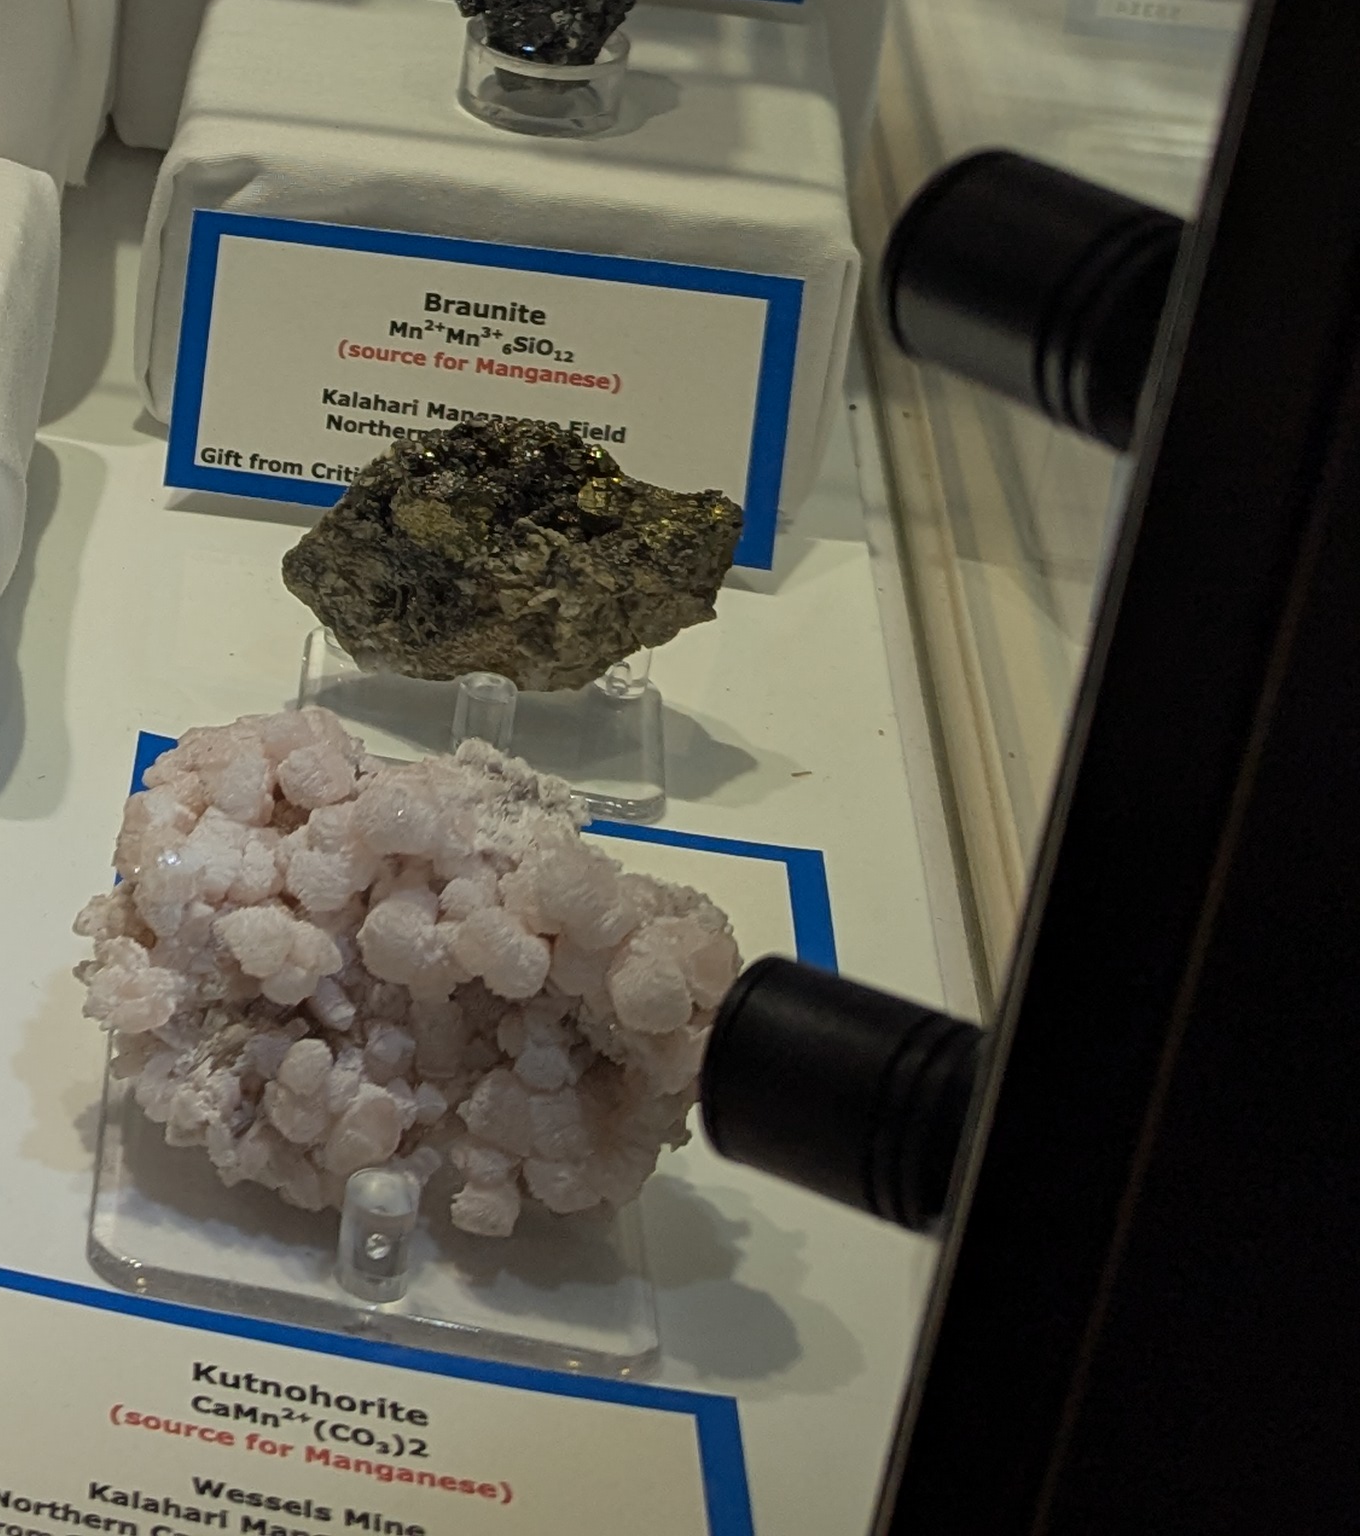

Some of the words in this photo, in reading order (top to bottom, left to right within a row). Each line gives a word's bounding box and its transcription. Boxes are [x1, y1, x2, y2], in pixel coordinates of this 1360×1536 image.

[424, 292, 546, 326] Braunite
[337, 339, 427, 367] (source
[433, 351, 469, 371] for
[475, 357, 621, 394] Manganese)
[321, 388, 419, 416] Kalahari
[569, 420, 627, 444] Field
[200, 446, 243, 468] Gift
[248, 452, 303, 476] from
[192, 1362, 428, 1426] Kutnohorite
[109, 1404, 235, 1446] (source
[245, 1432, 294, 1458] for
[304, 1445, 513, 1504] Manganese)
[88, 1481, 228, 1529] Kalahari
[192, 1476, 331, 1522] Wessels
